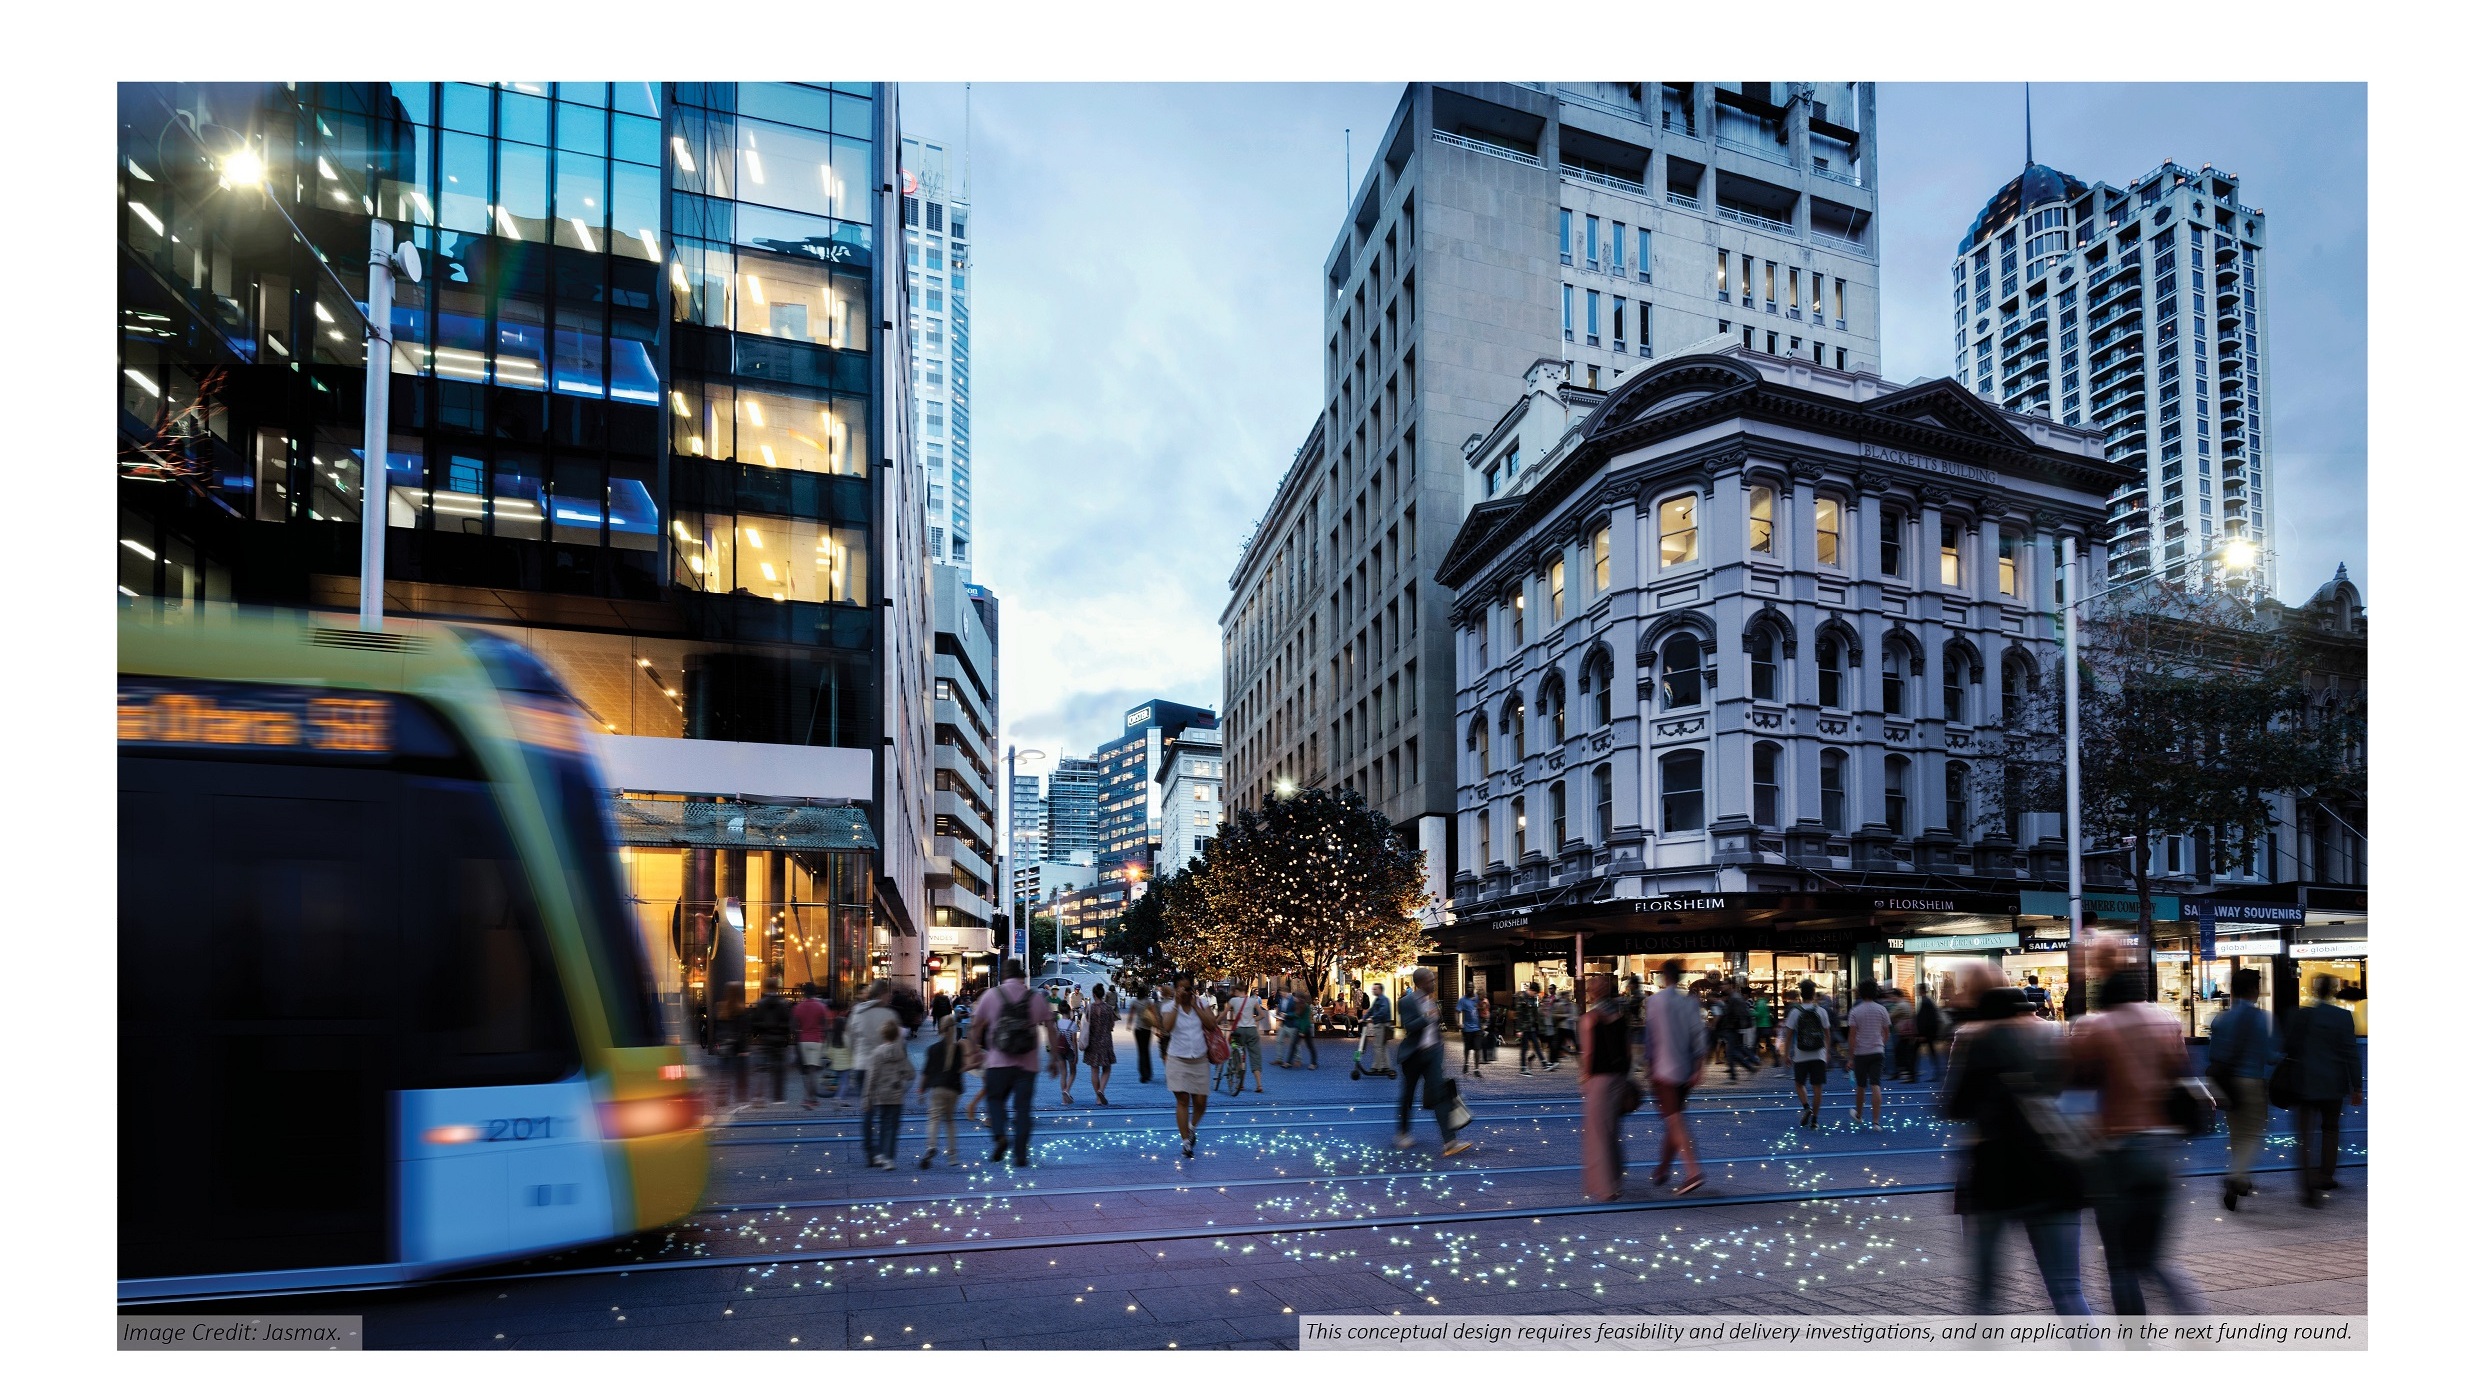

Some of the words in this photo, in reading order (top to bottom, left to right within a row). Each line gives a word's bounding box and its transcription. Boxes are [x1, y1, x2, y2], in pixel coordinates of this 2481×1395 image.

[1941, 460, 1996, 484] BUILDING
[1635, 898, 1725, 913] FLORSHEIM
[1889, 899, 1954, 911] FLORSHEIM
[2117, 901, 2157, 914] COMPY
[2243, 906, 2302, 920] SOUVENIRS
[1492, 917, 1529, 930] FLORSHEIM
[1625, 934, 1735, 950] FLORSHEIM
[2029, 942, 2049, 950] SAIL
[488, 1115, 551, 1142] 201
